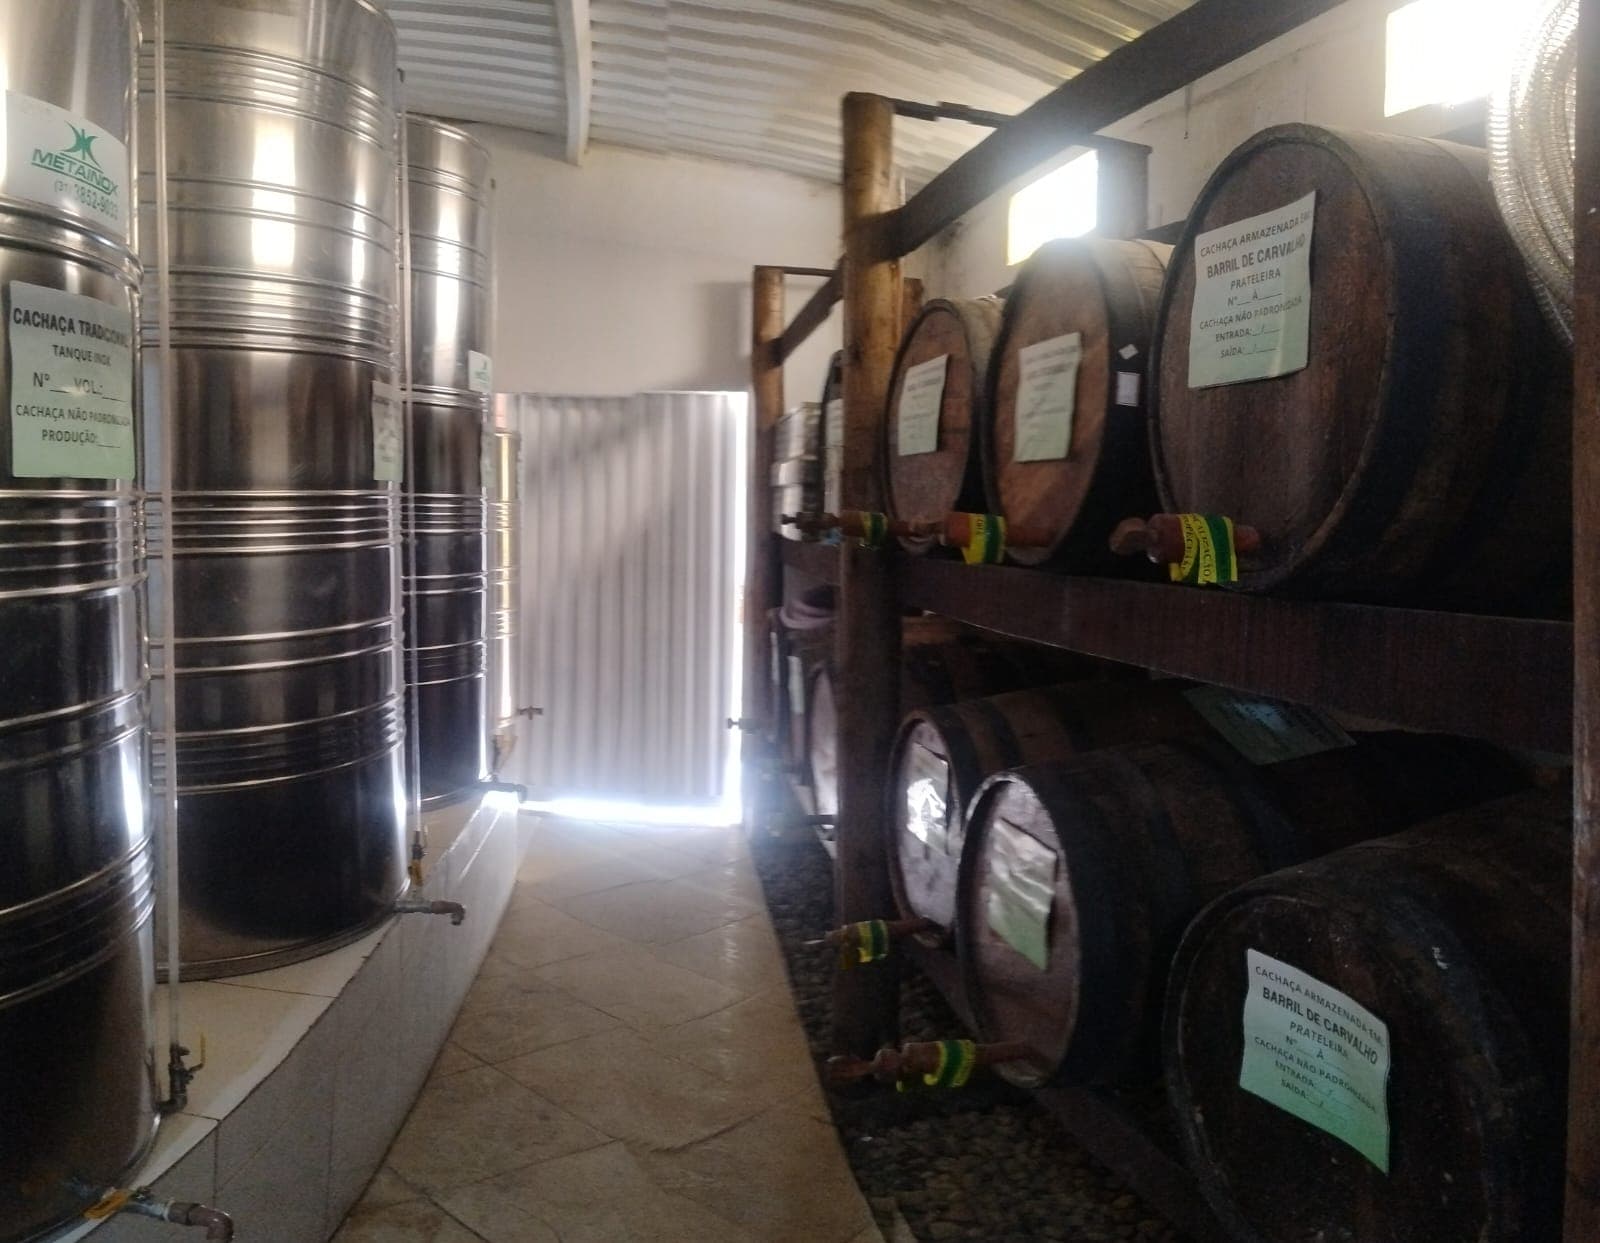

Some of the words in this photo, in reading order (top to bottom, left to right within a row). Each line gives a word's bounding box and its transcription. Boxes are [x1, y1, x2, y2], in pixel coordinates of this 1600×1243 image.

[32, 149, 118, 196] METAINOX
[1200, 238, 1237, 257] CACHAÇA
[1239, 219, 1299, 246] ARMAZENADA
[1207, 260, 1240, 279] BARRIL
[1241, 253, 1255, 268] DE
[1256, 233, 1306, 263] CARVALHO
[1230, 268, 1281, 290] PRATELEIRA
[13, 307, 76, 337] CACHAÇA
[1200, 314, 1234, 330] CACHAÇA
[1235, 309, 1252, 323] NÃO
[52, 344, 93, 363] TANQUE
[94, 352, 112, 367] INOX
[16, 404, 65, 422] CACHAÇA
[67, 407, 87, 421] NÃO
[89, 411, 130, 427] PADRONI
[1255, 966, 1304, 993] CACHAÇA
[1304, 988, 1367, 1032] ARMAZENADA
[1263, 987, 1304, 1017] BARRIL
[1306, 1008, 1321, 1025] DE
[1324, 1019, 1378, 1065] CARVALHO
[1289, 1021, 1348, 1058] PRATELEIRA
[1254, 1036, 1294, 1062] CACHAÇA
[1296, 1057, 1317, 1074] NÃO
